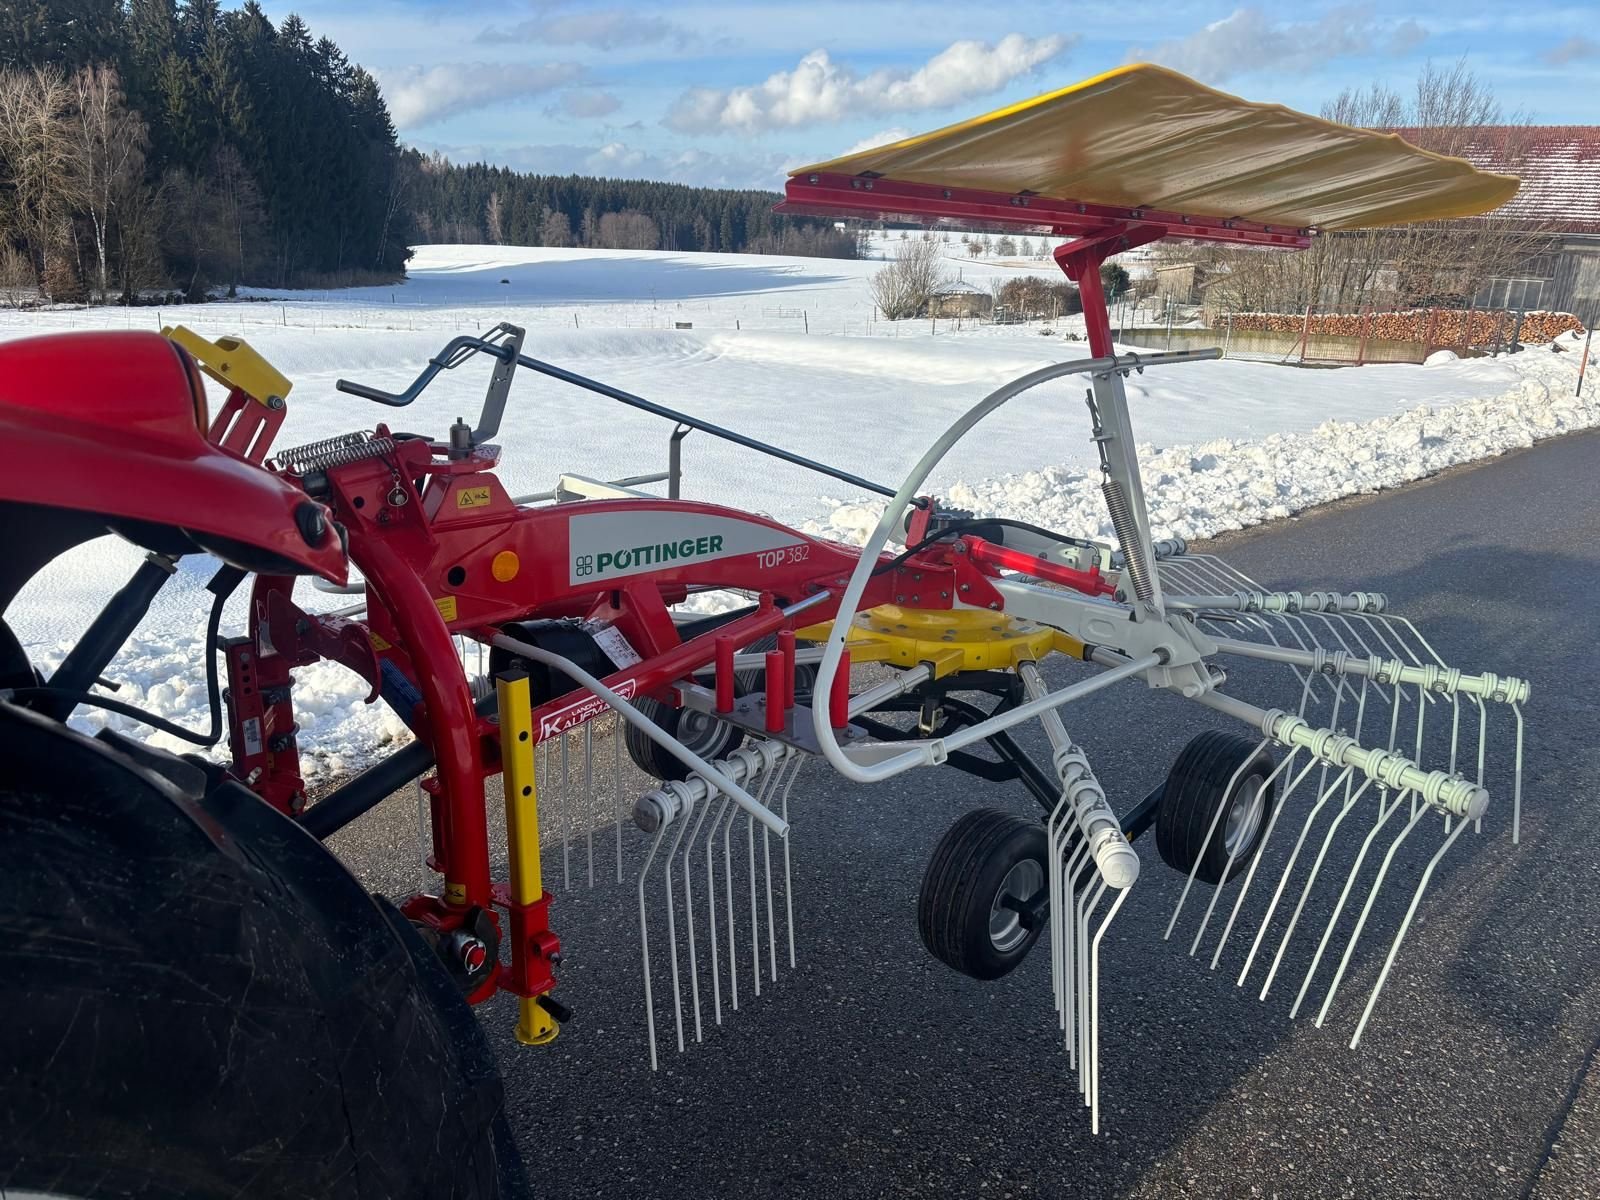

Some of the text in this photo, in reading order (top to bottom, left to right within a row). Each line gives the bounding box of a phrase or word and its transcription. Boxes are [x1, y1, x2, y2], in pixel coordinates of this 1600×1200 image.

[596, 535, 724, 573] PÖTTINGER
[757, 545, 810, 569] TOP 382
